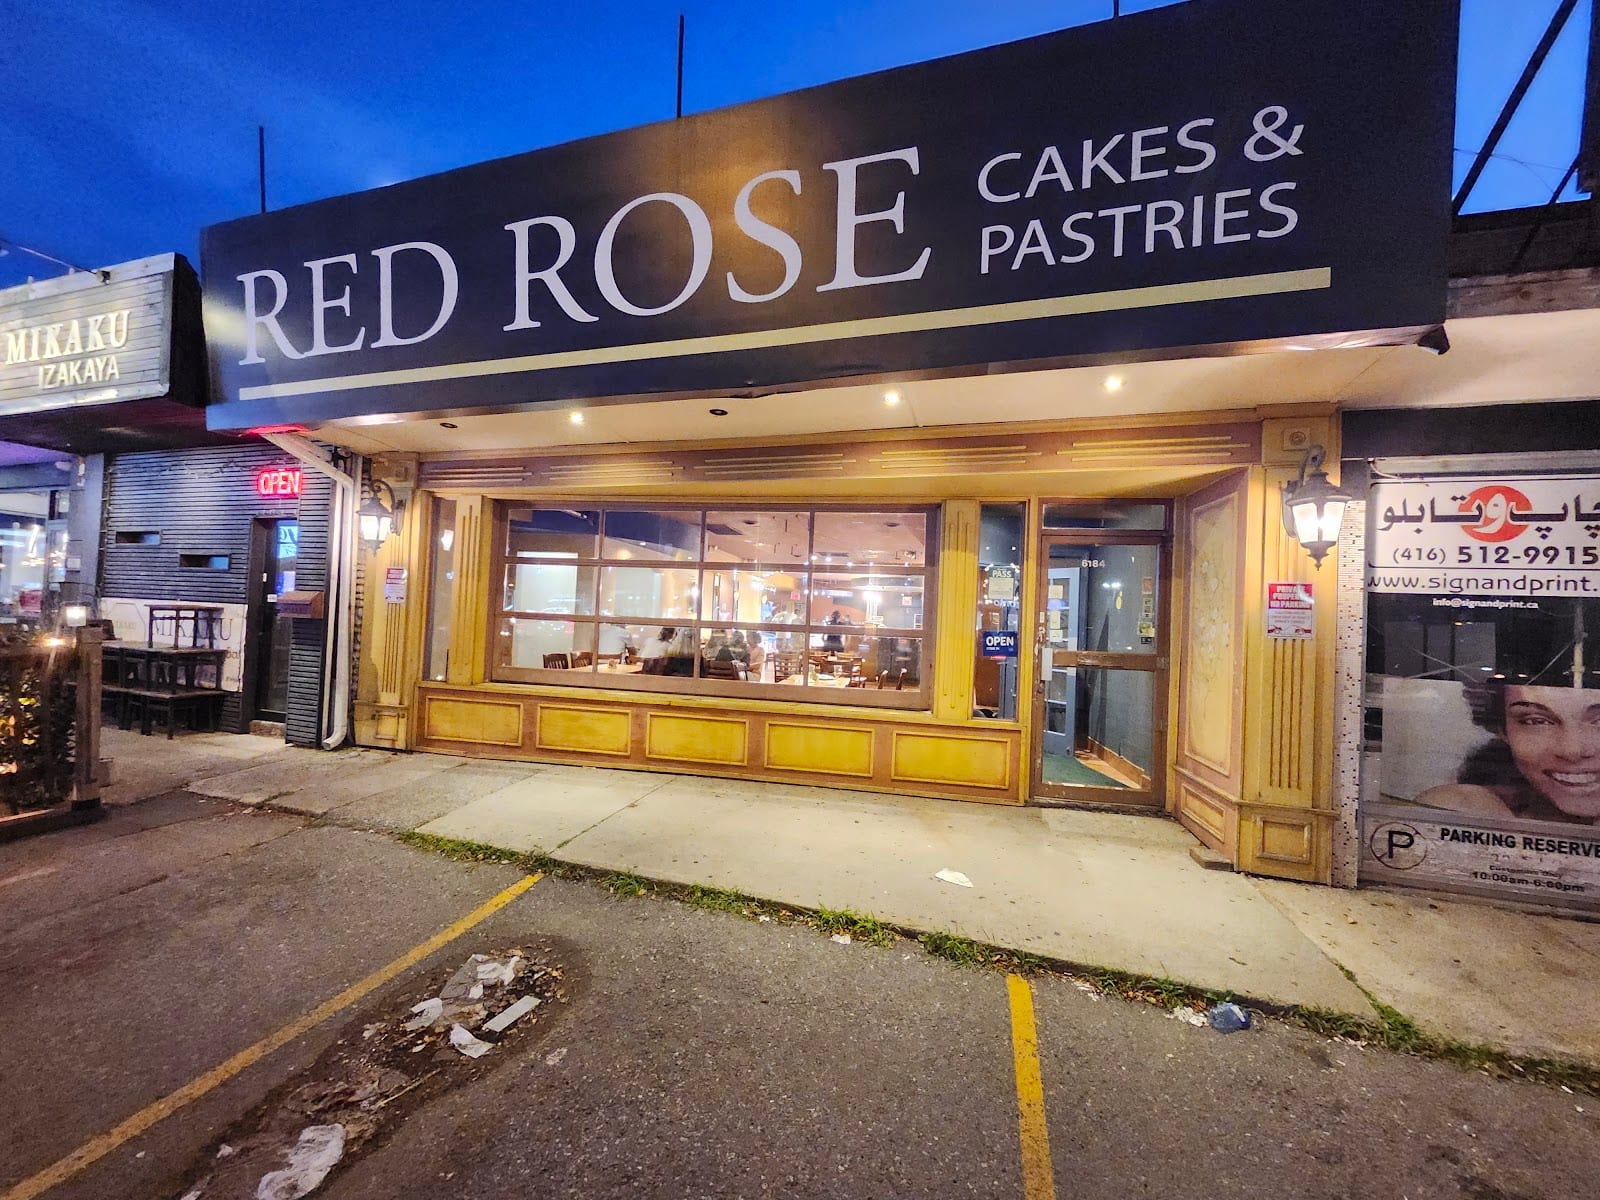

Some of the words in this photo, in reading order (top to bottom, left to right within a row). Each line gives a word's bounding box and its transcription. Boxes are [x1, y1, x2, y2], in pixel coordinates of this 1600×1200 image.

[977, 117, 1217, 203] CAKES
[1243, 105, 1304, 162] &
[980, 181, 1299, 275] PASTRIES
[236, 241, 459, 365] RED
[503, 147, 932, 332] ROSE
[5, 310, 131, 365] MIKAKU
[38, 355, 120, 389] IZAKAYA
[260, 470, 300, 495] OPEN
[1081, 559, 1105, 568] 6184
[1393, 547, 1446, 564] (416)
[1457, 546, 1599, 565] 512-9915
[992, 569, 1012, 578] PASS
[1432, 597, 1539, 610] info@signandprint.ca
[986, 636, 1014, 646] OPEN
[1440, 827, 1517, 849] PARKING
